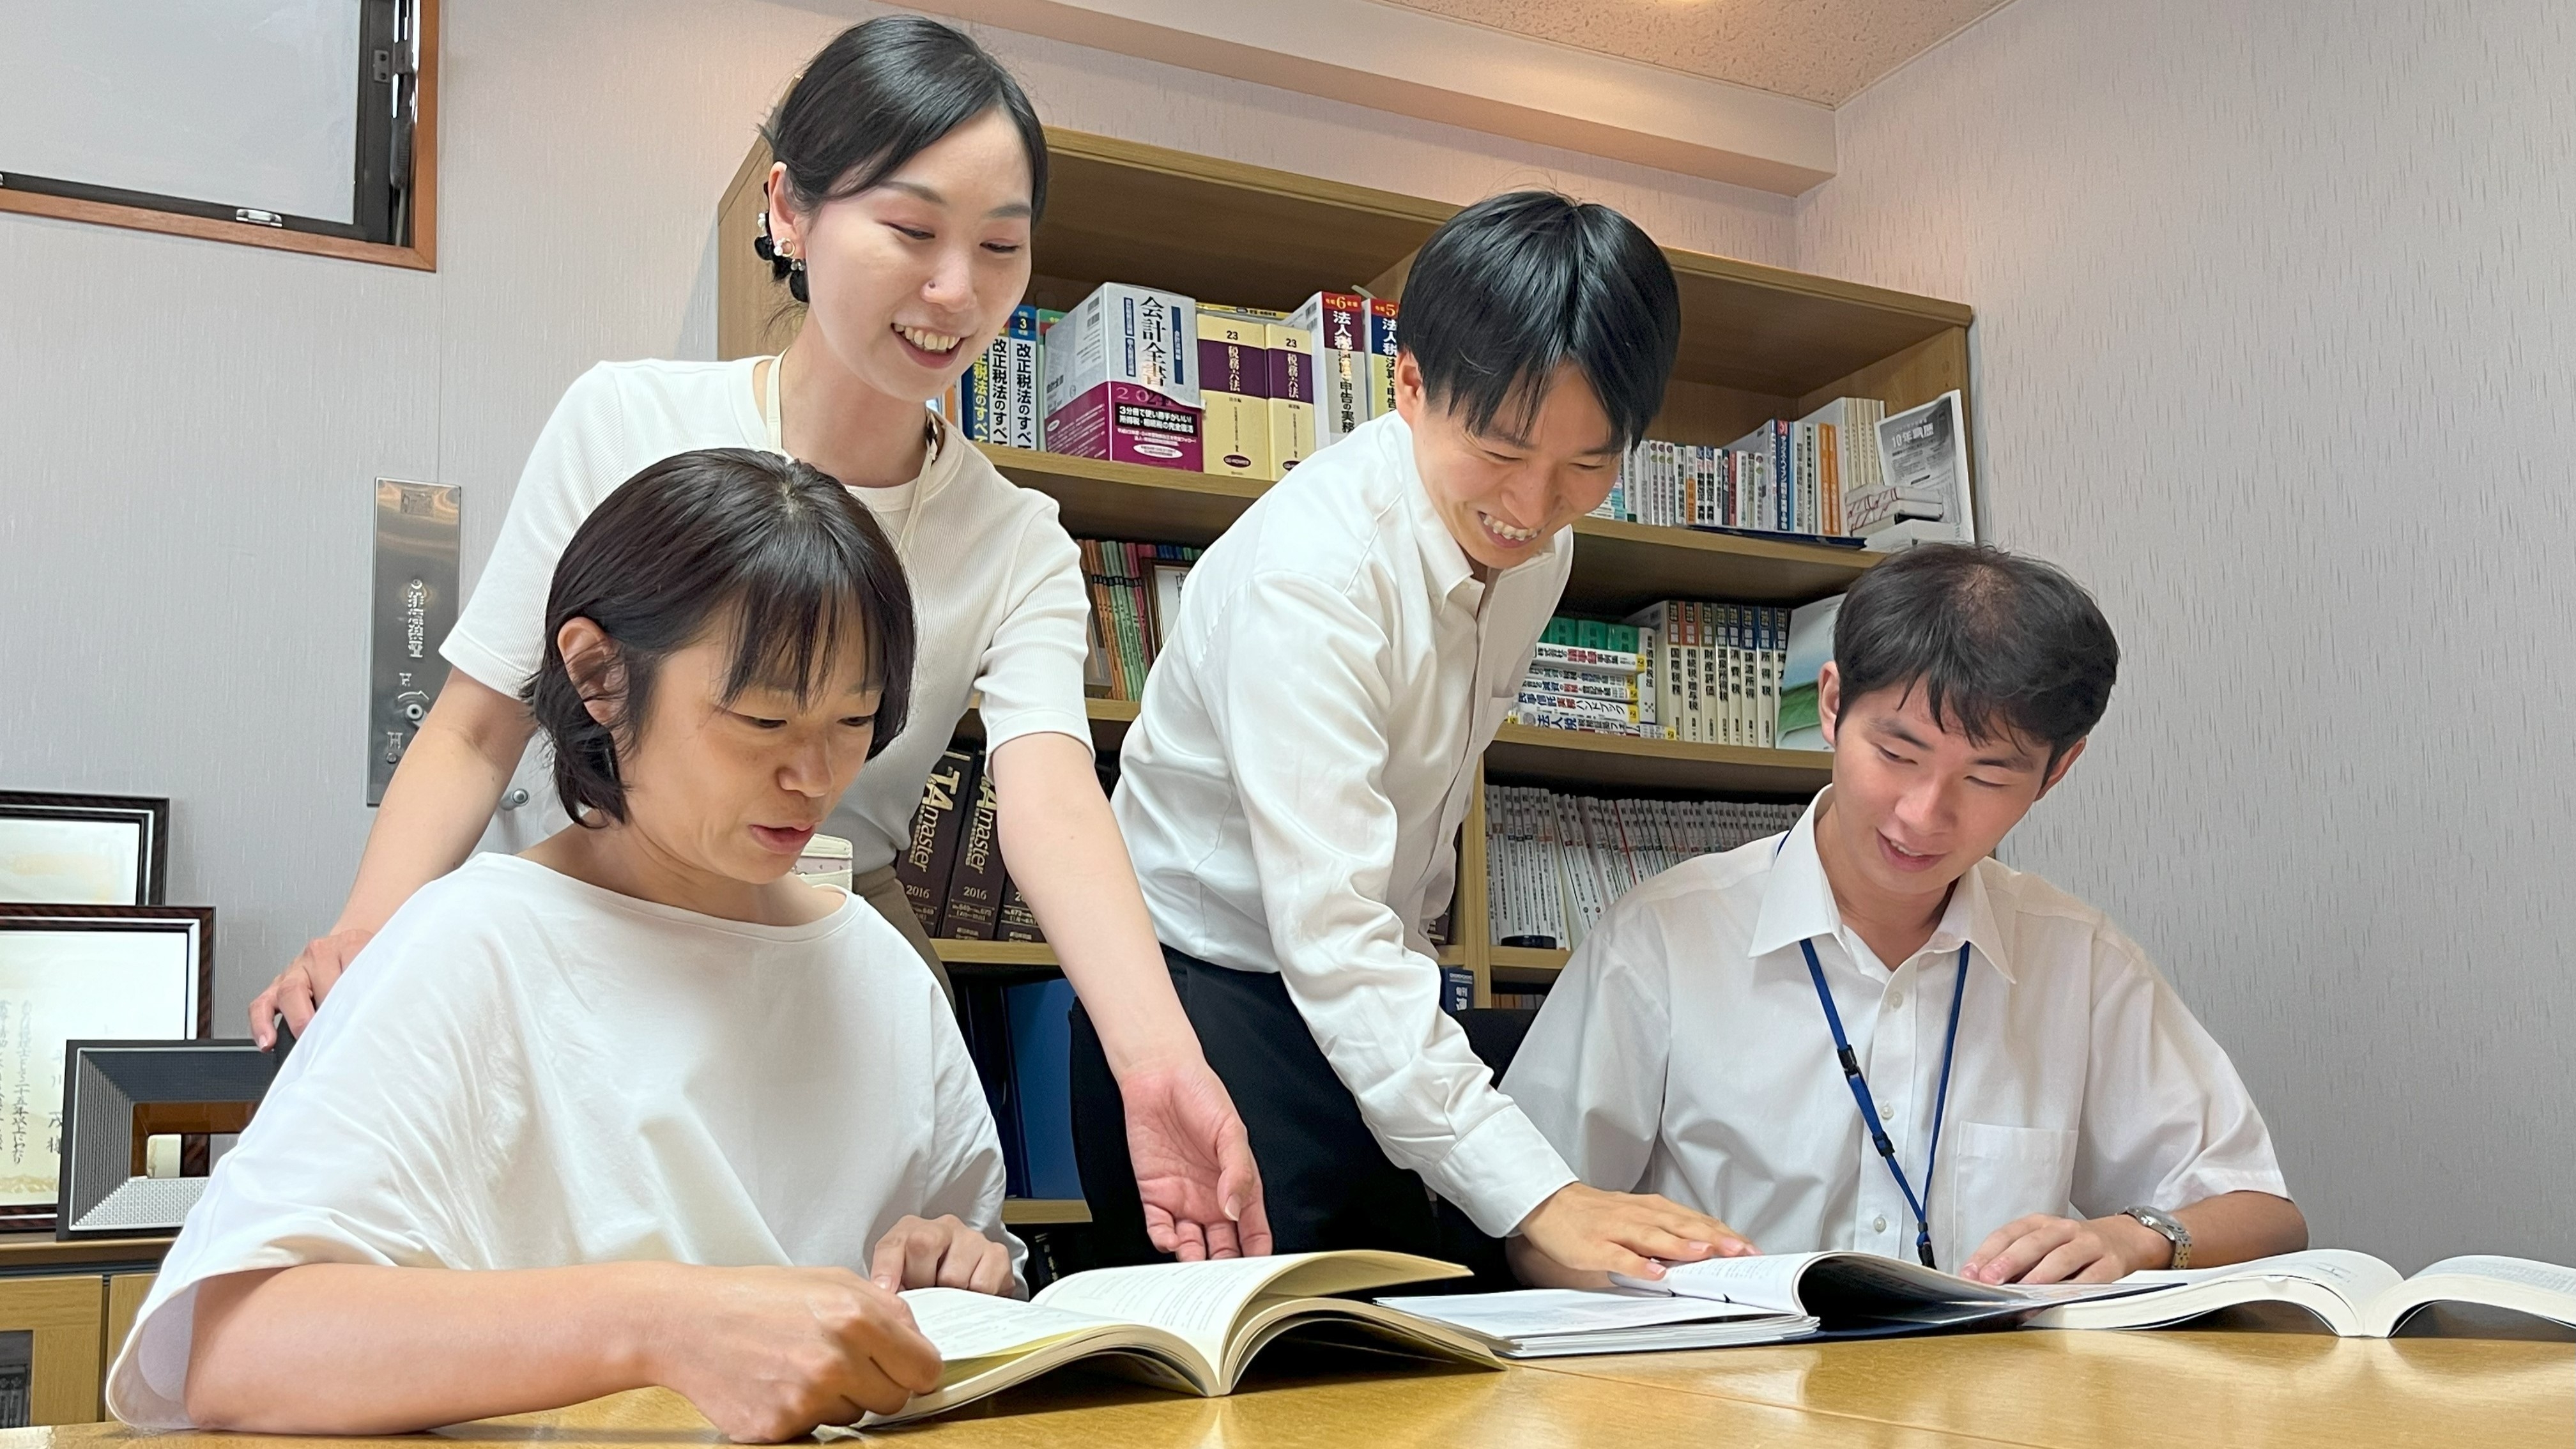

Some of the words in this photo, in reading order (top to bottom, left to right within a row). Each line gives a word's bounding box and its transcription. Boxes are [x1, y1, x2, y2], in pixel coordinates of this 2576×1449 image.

[1226, 330, 1238, 341] 23
[1285, 338, 1297, 348] 23
[1228, 346, 1241, 392] 税務六法
[1287, 353, 1299, 399] 税務六法
[1730, 649, 1741, 694] 消費税
[1761, 652, 1772, 697] 所得税
[1518, 691, 1625, 715] 民事信託実務ハンドブック
[906, 885, 931, 899] 2016
[963, 887, 987, 900] 2016
